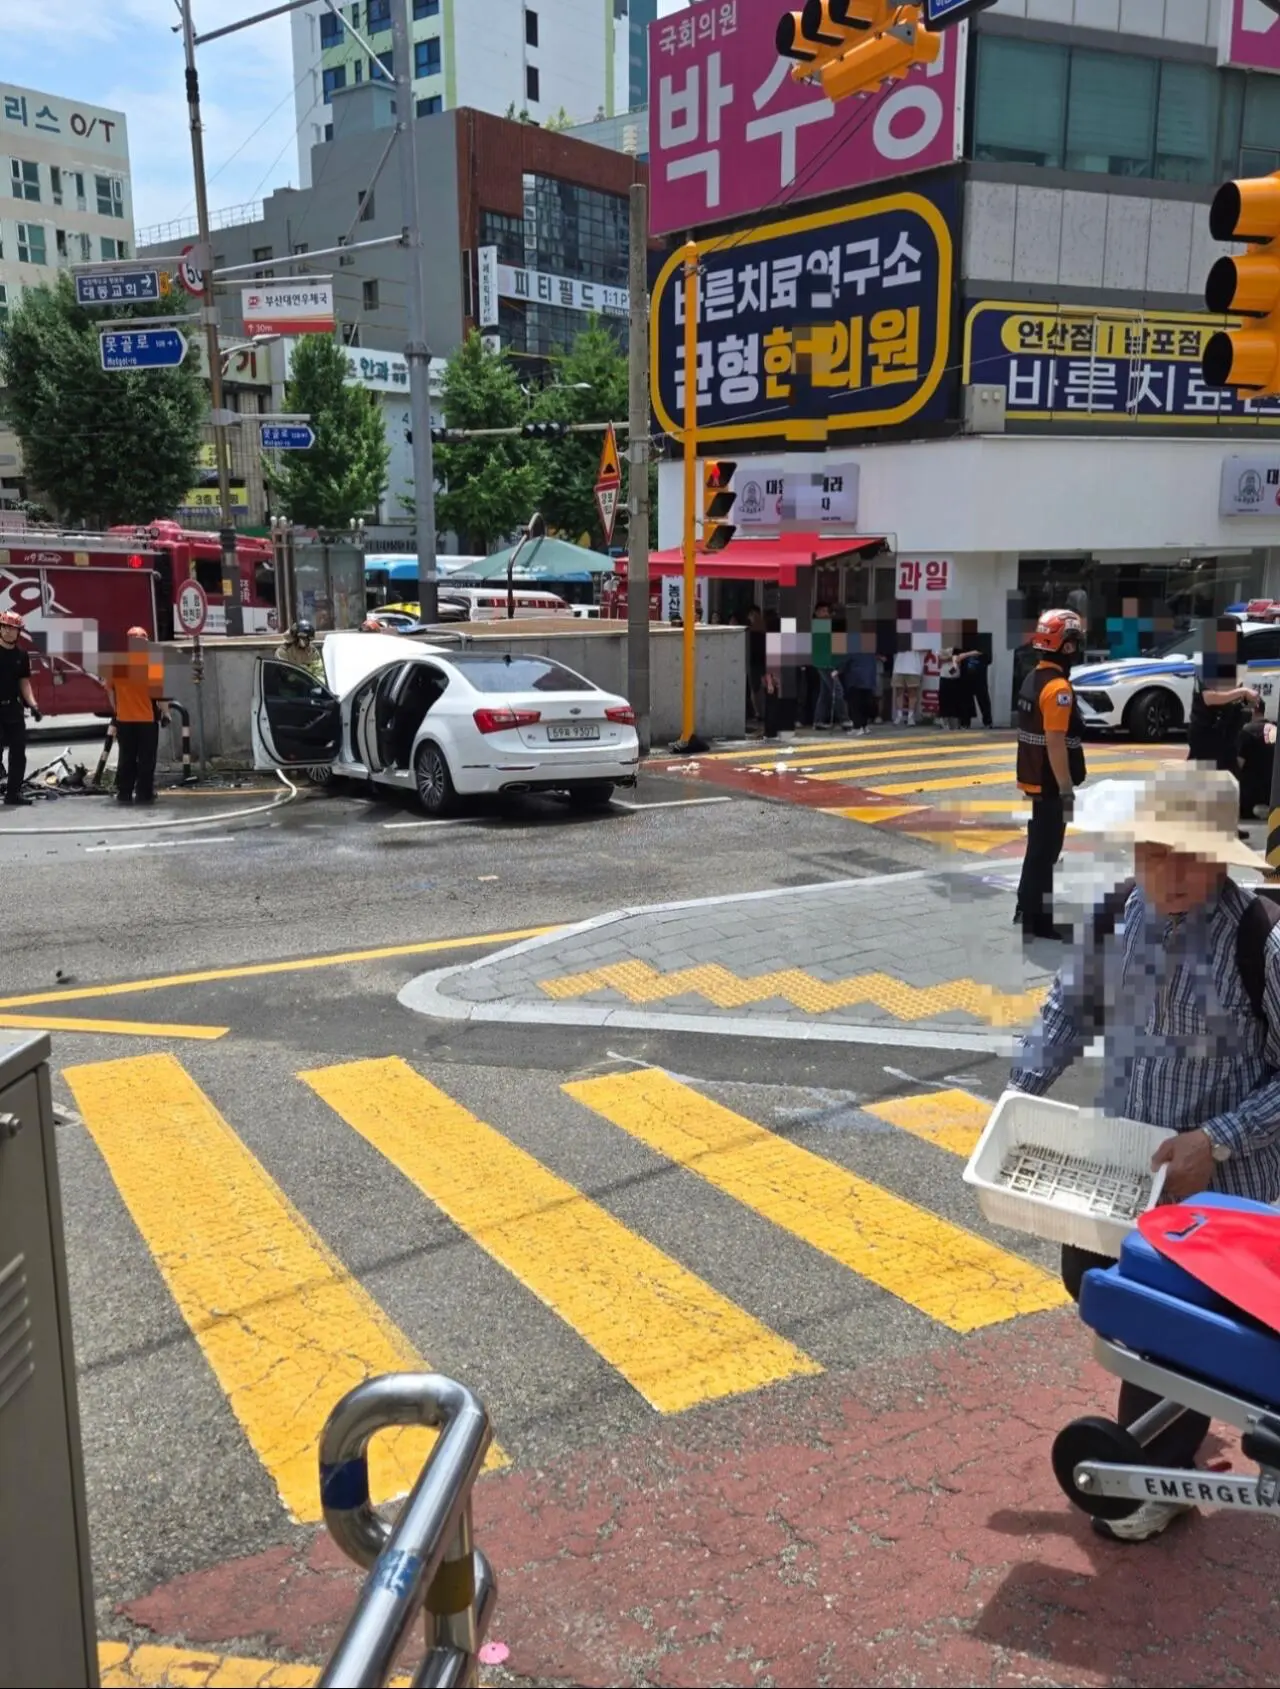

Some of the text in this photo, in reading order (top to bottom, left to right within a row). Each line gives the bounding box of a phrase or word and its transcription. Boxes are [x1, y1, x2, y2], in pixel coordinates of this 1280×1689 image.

[659, 0, 737, 56] 국회의원
[105, 335, 149, 353] 못골로
[1018, 319, 1095, 352] 연산점
[898, 560, 949, 592] 과일
